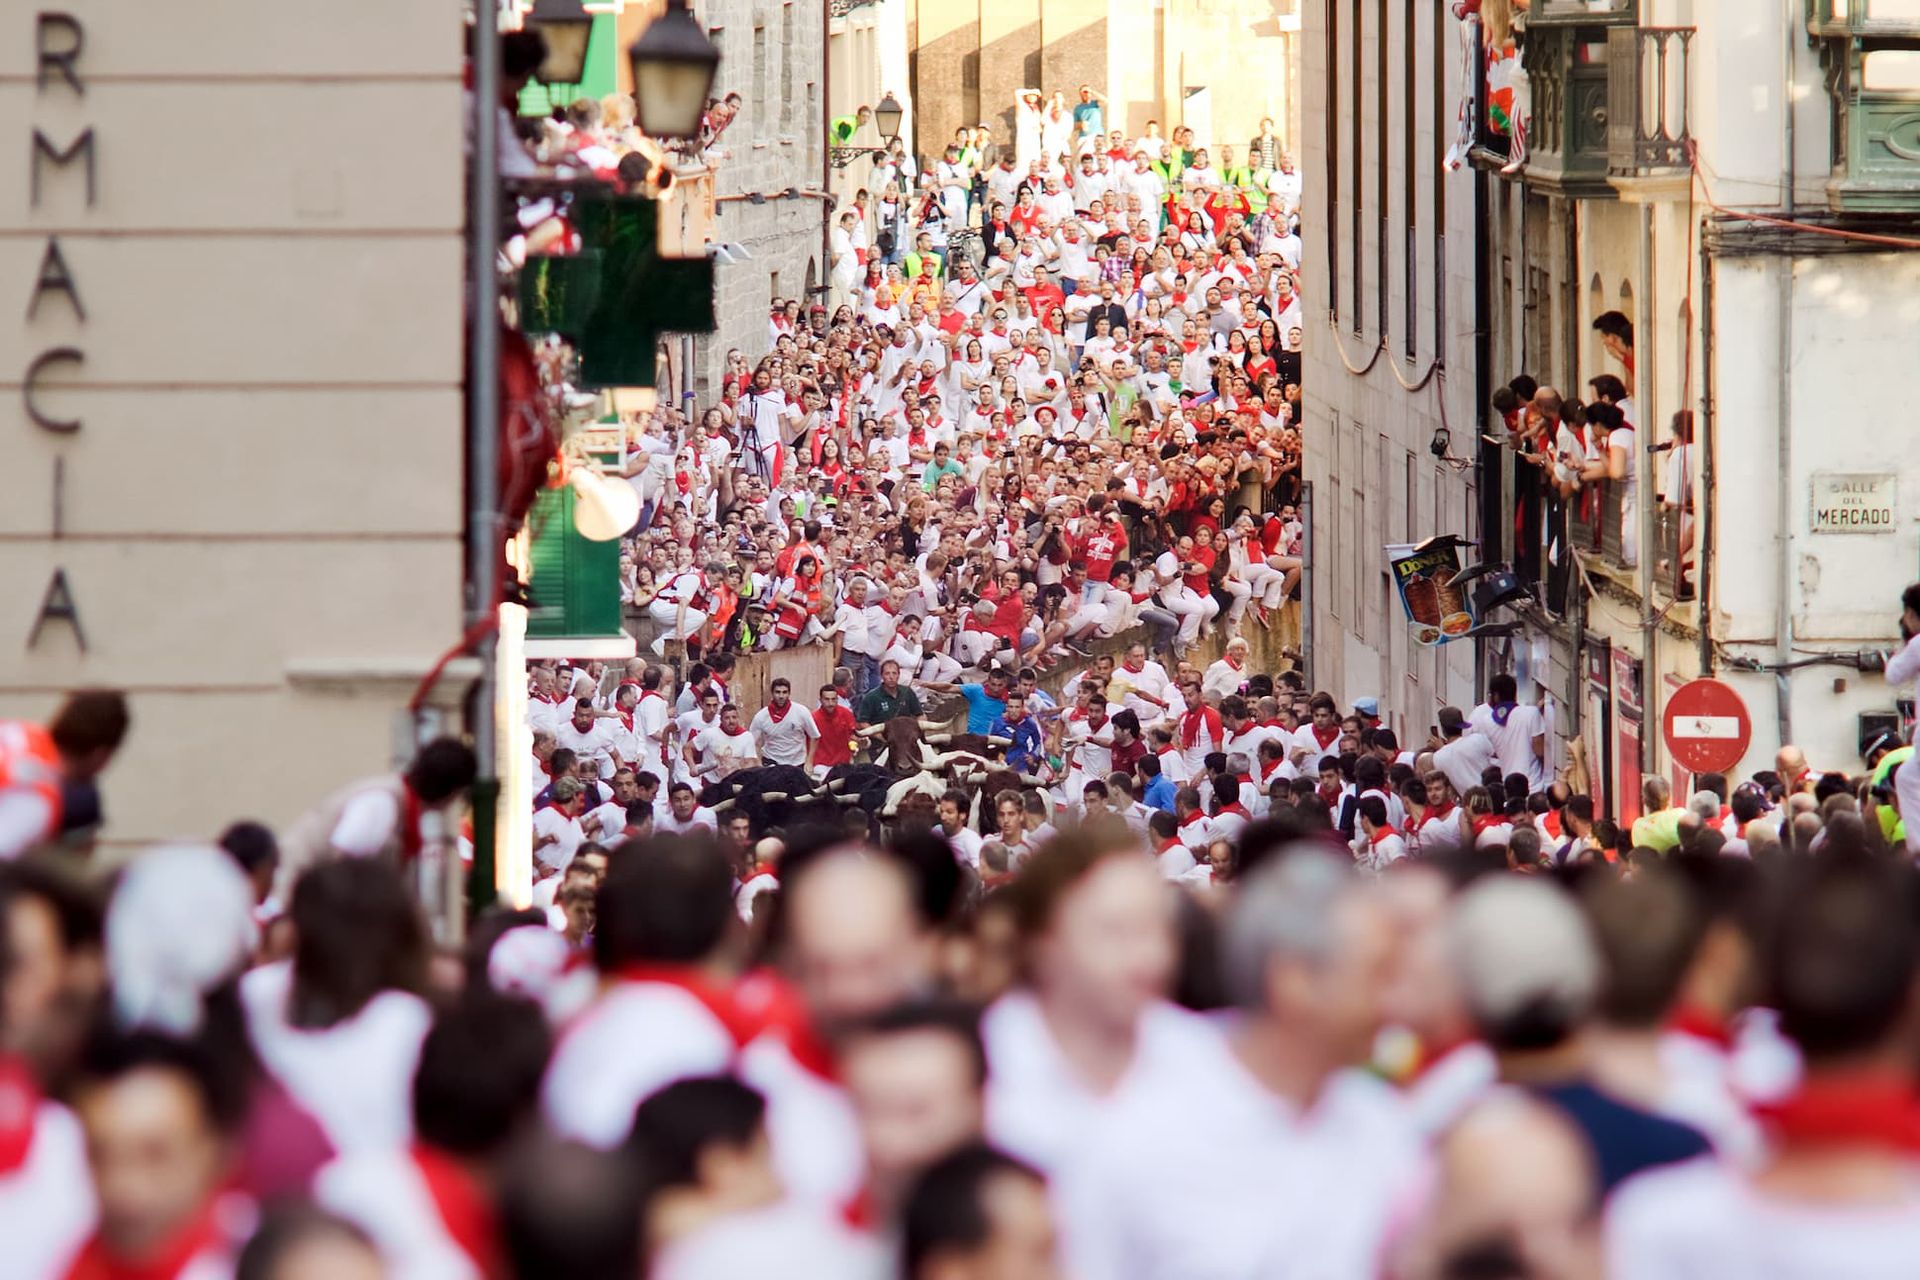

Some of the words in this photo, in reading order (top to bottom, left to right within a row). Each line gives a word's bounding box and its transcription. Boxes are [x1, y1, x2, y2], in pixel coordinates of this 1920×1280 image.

[22, 12, 97, 654] RMACIA
[1829, 481, 1878, 494] CALLE
[1842, 497, 1865, 505] DEL
[1817, 508, 1890, 525] MERCADO
